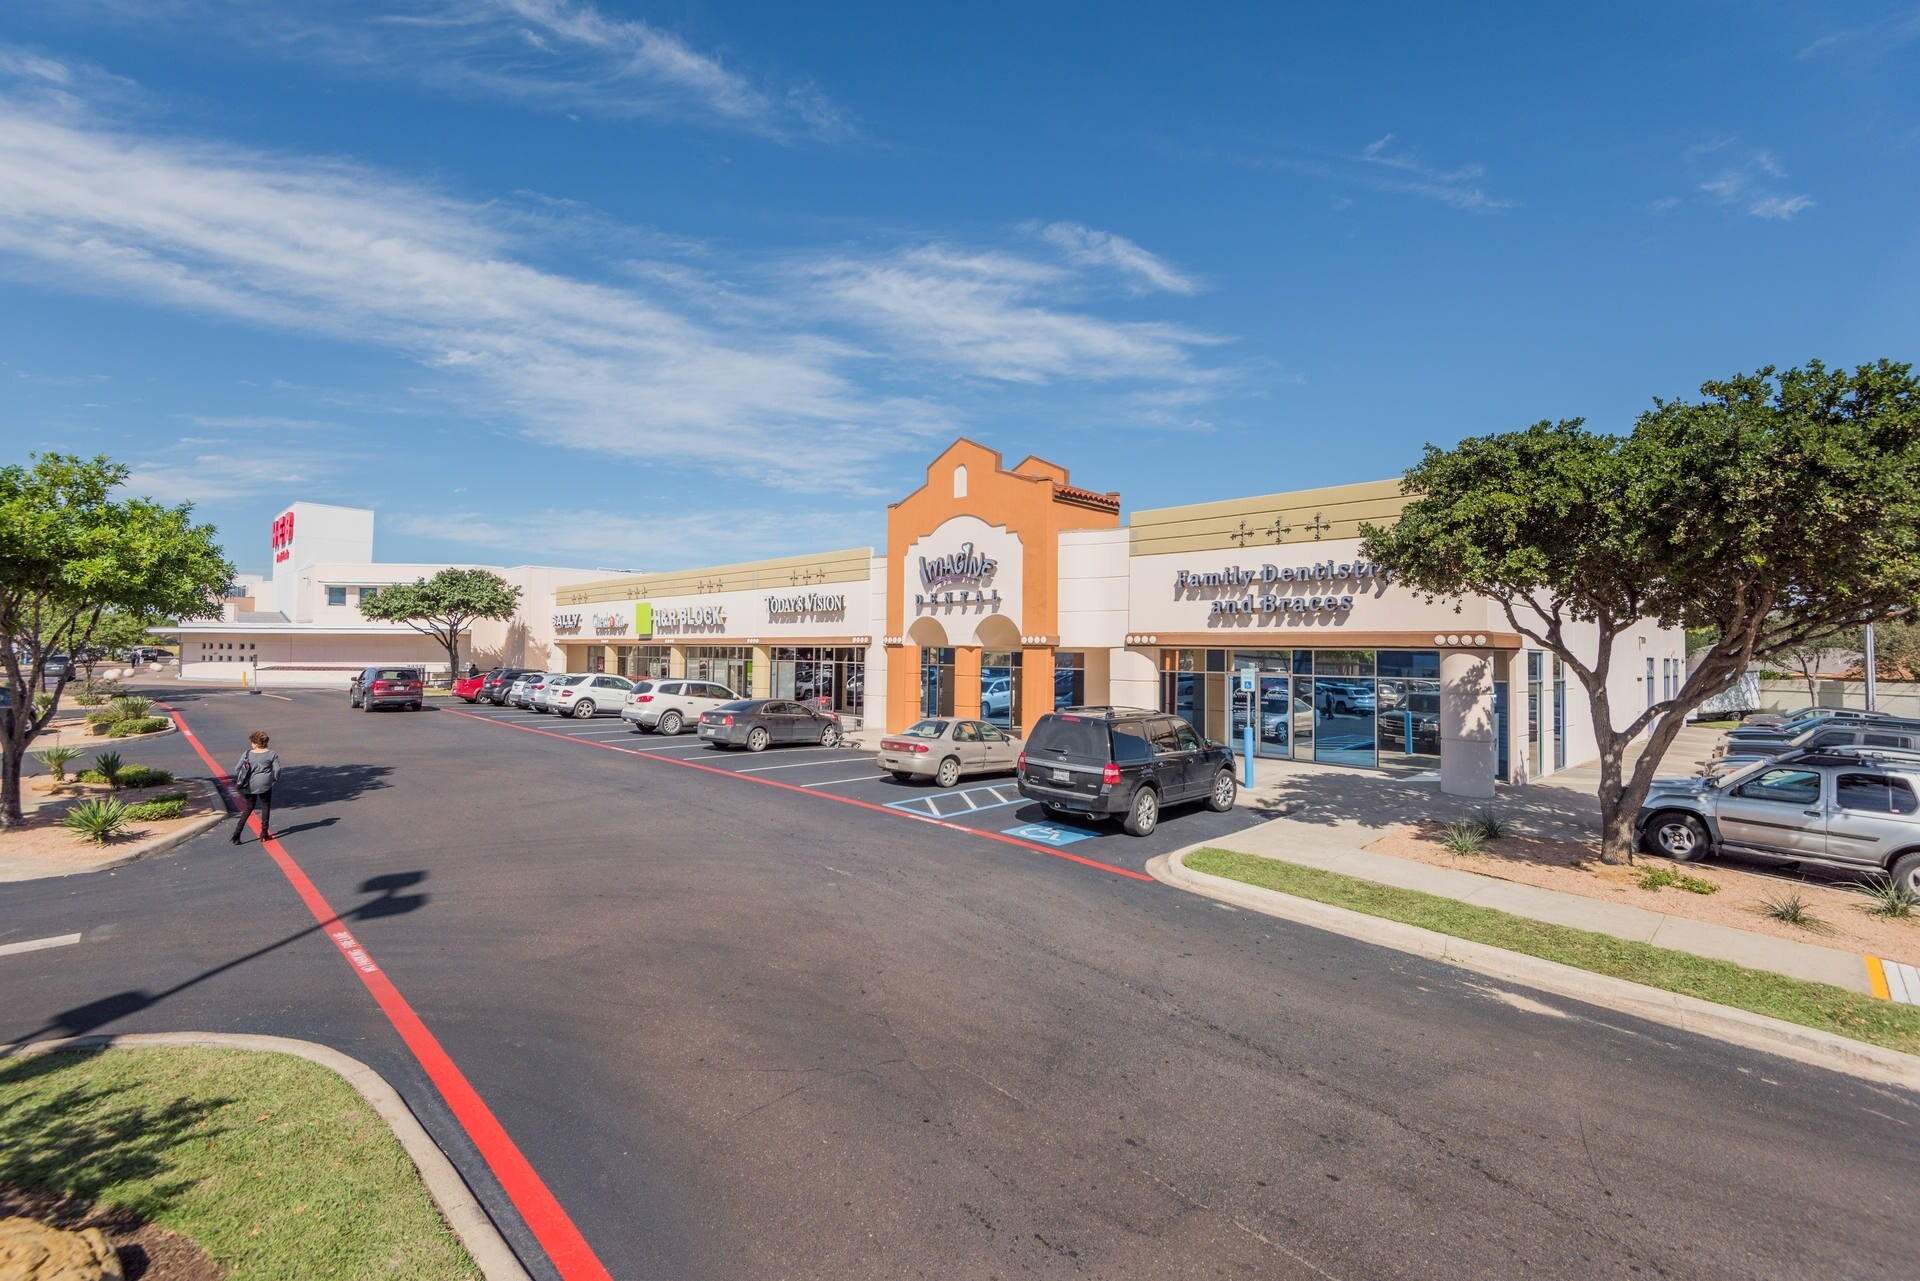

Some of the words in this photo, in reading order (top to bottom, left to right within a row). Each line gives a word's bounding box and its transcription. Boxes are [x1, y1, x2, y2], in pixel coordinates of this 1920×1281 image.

[1176, 565, 1256, 588] Family
[807, 593, 845, 612] VISION
[915, 589, 1001, 604] DENTAL
[1211, 593, 1254, 614] and
[1261, 593, 1354, 613] Braces
[552, 613, 582, 627] SALLY
[655, 608, 678, 627] H&R
[679, 605, 723, 625] BLOCK
